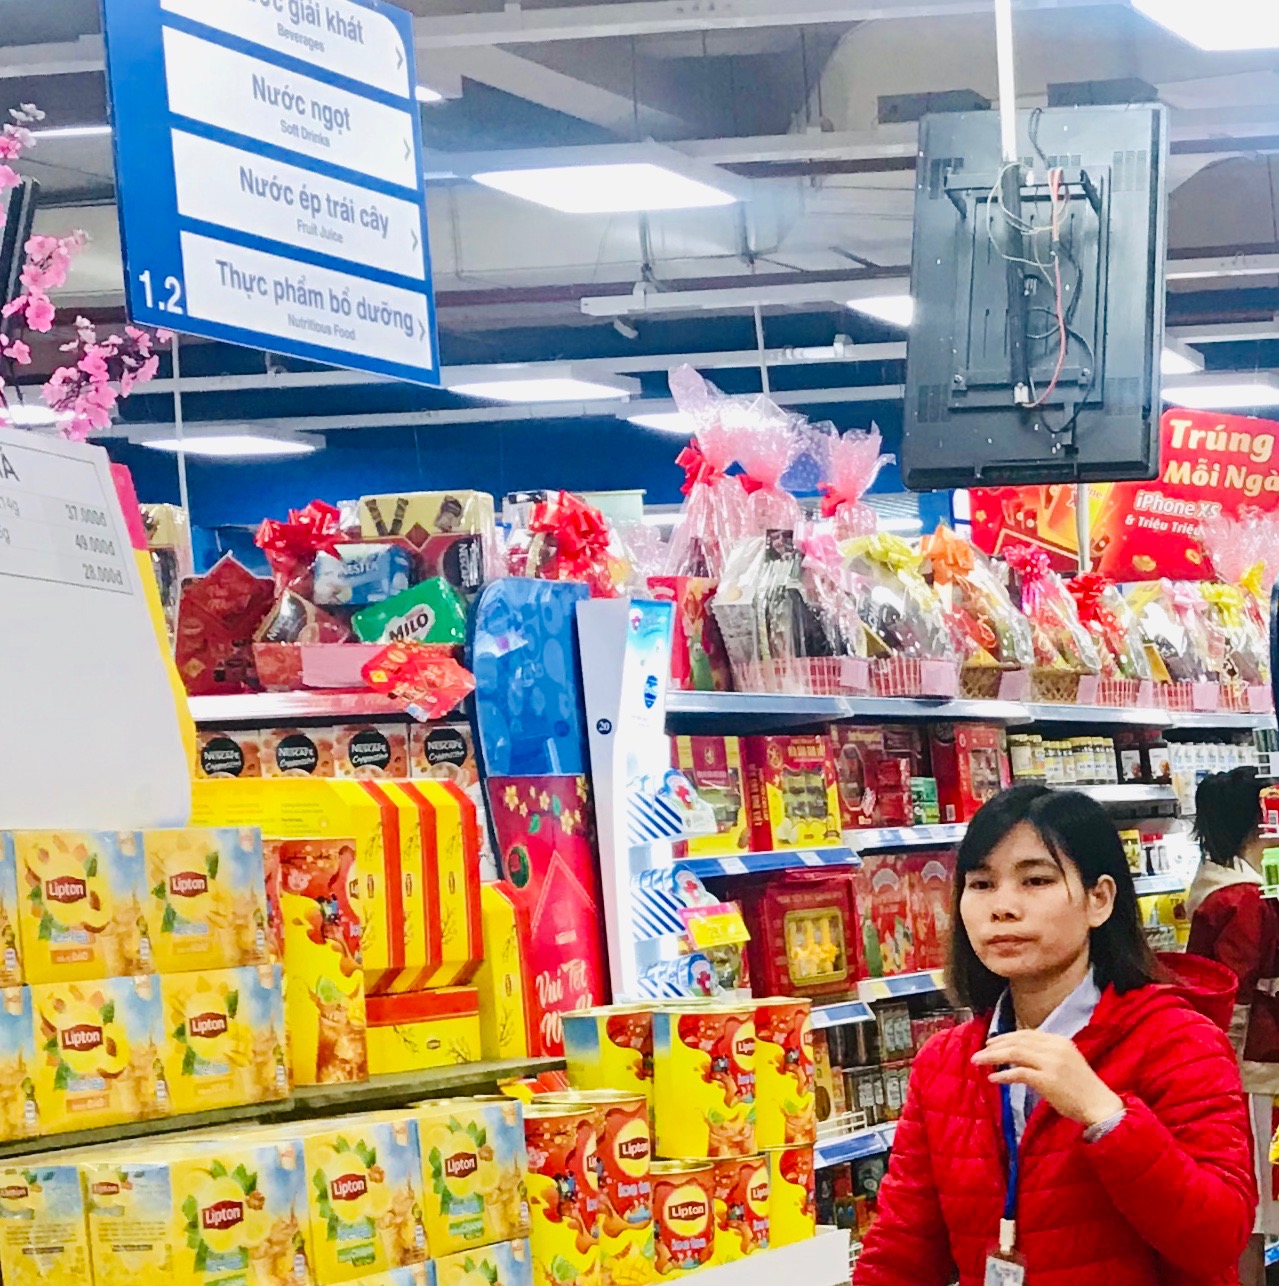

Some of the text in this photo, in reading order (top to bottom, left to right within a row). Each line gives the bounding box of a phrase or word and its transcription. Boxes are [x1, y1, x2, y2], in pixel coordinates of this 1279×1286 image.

[276, 22, 325, 53] Beverages
[325, 6, 364, 44] khát
[252, 74, 352, 134] Nước ngọt
[280, 119, 331, 148] Soft Drinks
[239, 166, 390, 239] Nước ép trái cây
[297, 219, 343, 244] Fruit Juice
[139, 269, 183, 315] 1.2
[216, 258, 414, 338] Thực phẩm bổ dưỡng
[287, 313, 357, 341] Nutritious Food
[1169, 419, 1275, 463] Trúng
[1163, 457, 1219, 487] Mỗi
[1134, 490, 1195, 518] iPhone
[1138, 514, 1169, 532] Triệu
[388, 612, 429, 640] MILO
[48, 882, 84, 897] Lipton
[171, 877, 206, 893] Lipton
[64, 1031, 100, 1047] Lipton
[192, 1019, 225, 1034] Lipton
[446, 1158, 476, 1173] Lipton
[332, 1180, 365, 1197] Lipton
[206, 1206, 241, 1224] Lipton
[672, 1203, 705, 1218] Lipton
